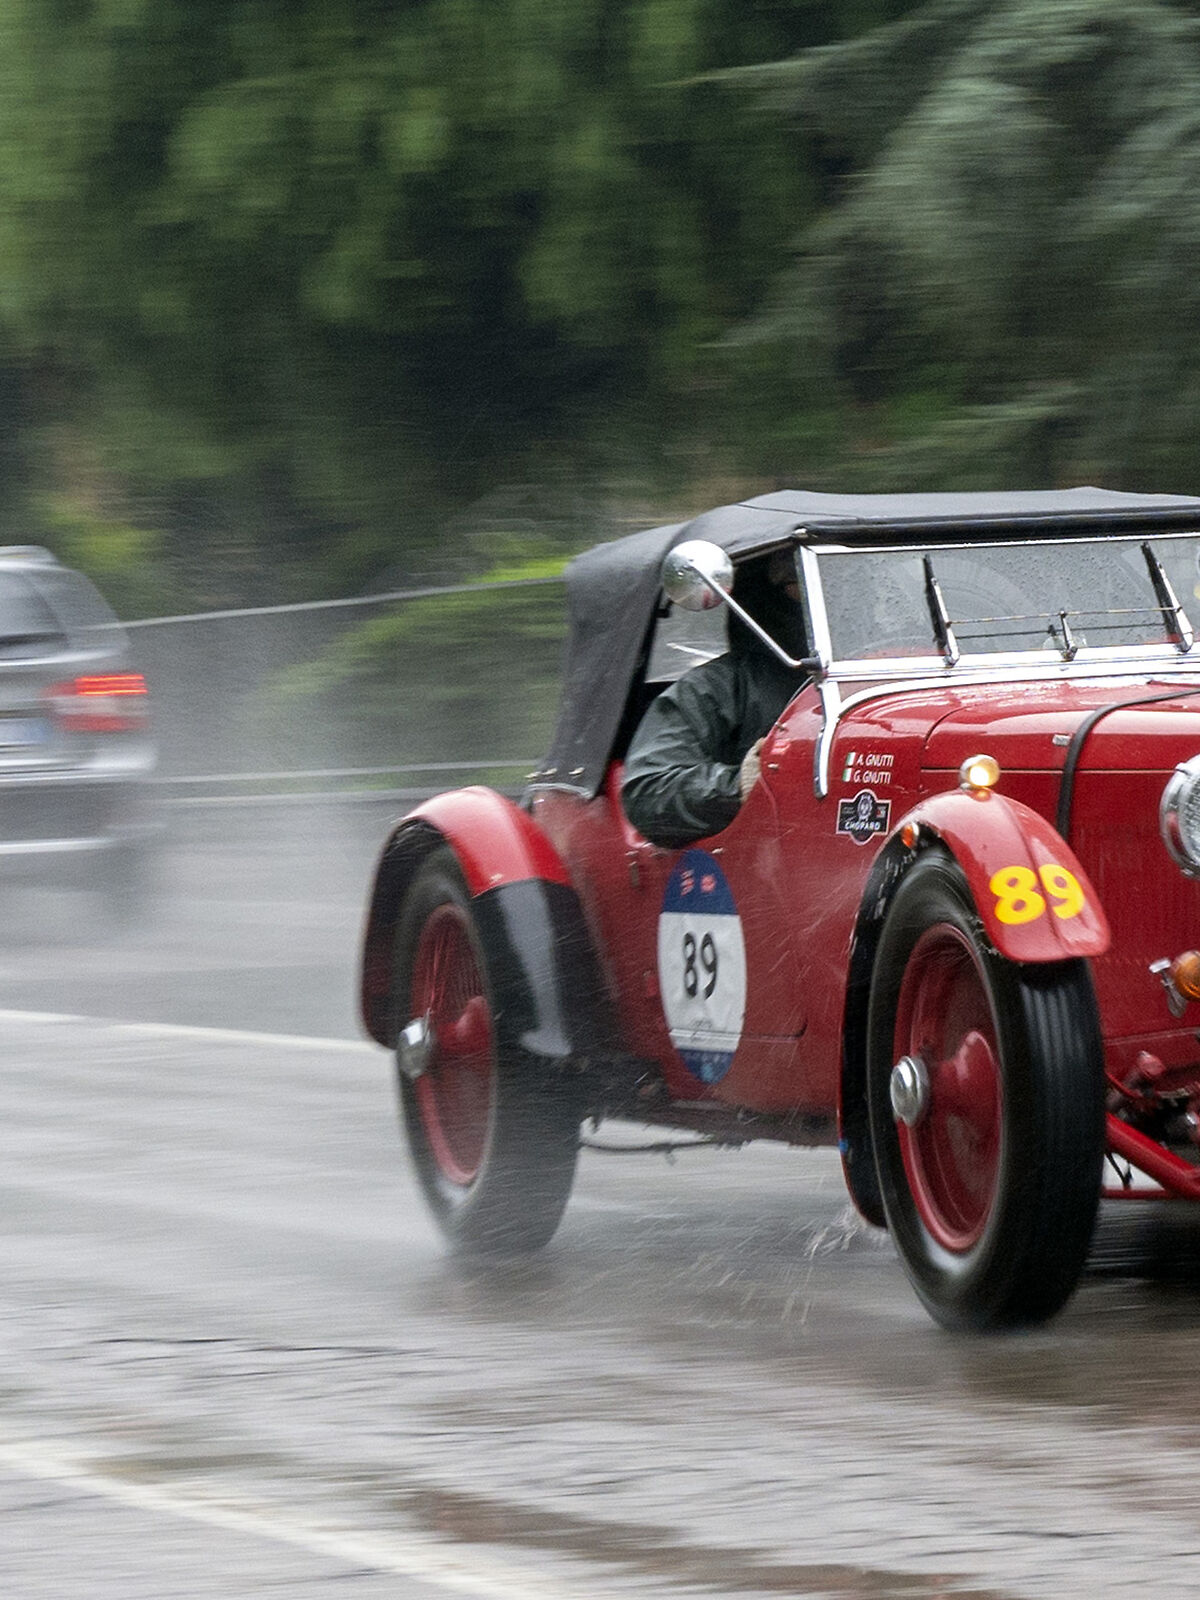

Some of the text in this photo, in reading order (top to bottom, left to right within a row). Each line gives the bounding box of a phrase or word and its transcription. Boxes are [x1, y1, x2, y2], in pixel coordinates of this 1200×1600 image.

[862, 770, 891, 784] GNUTTI
[865, 754, 894, 767] GNUTTI
[989, 863, 1085, 925] 89
[683, 932, 717, 1000] 89
